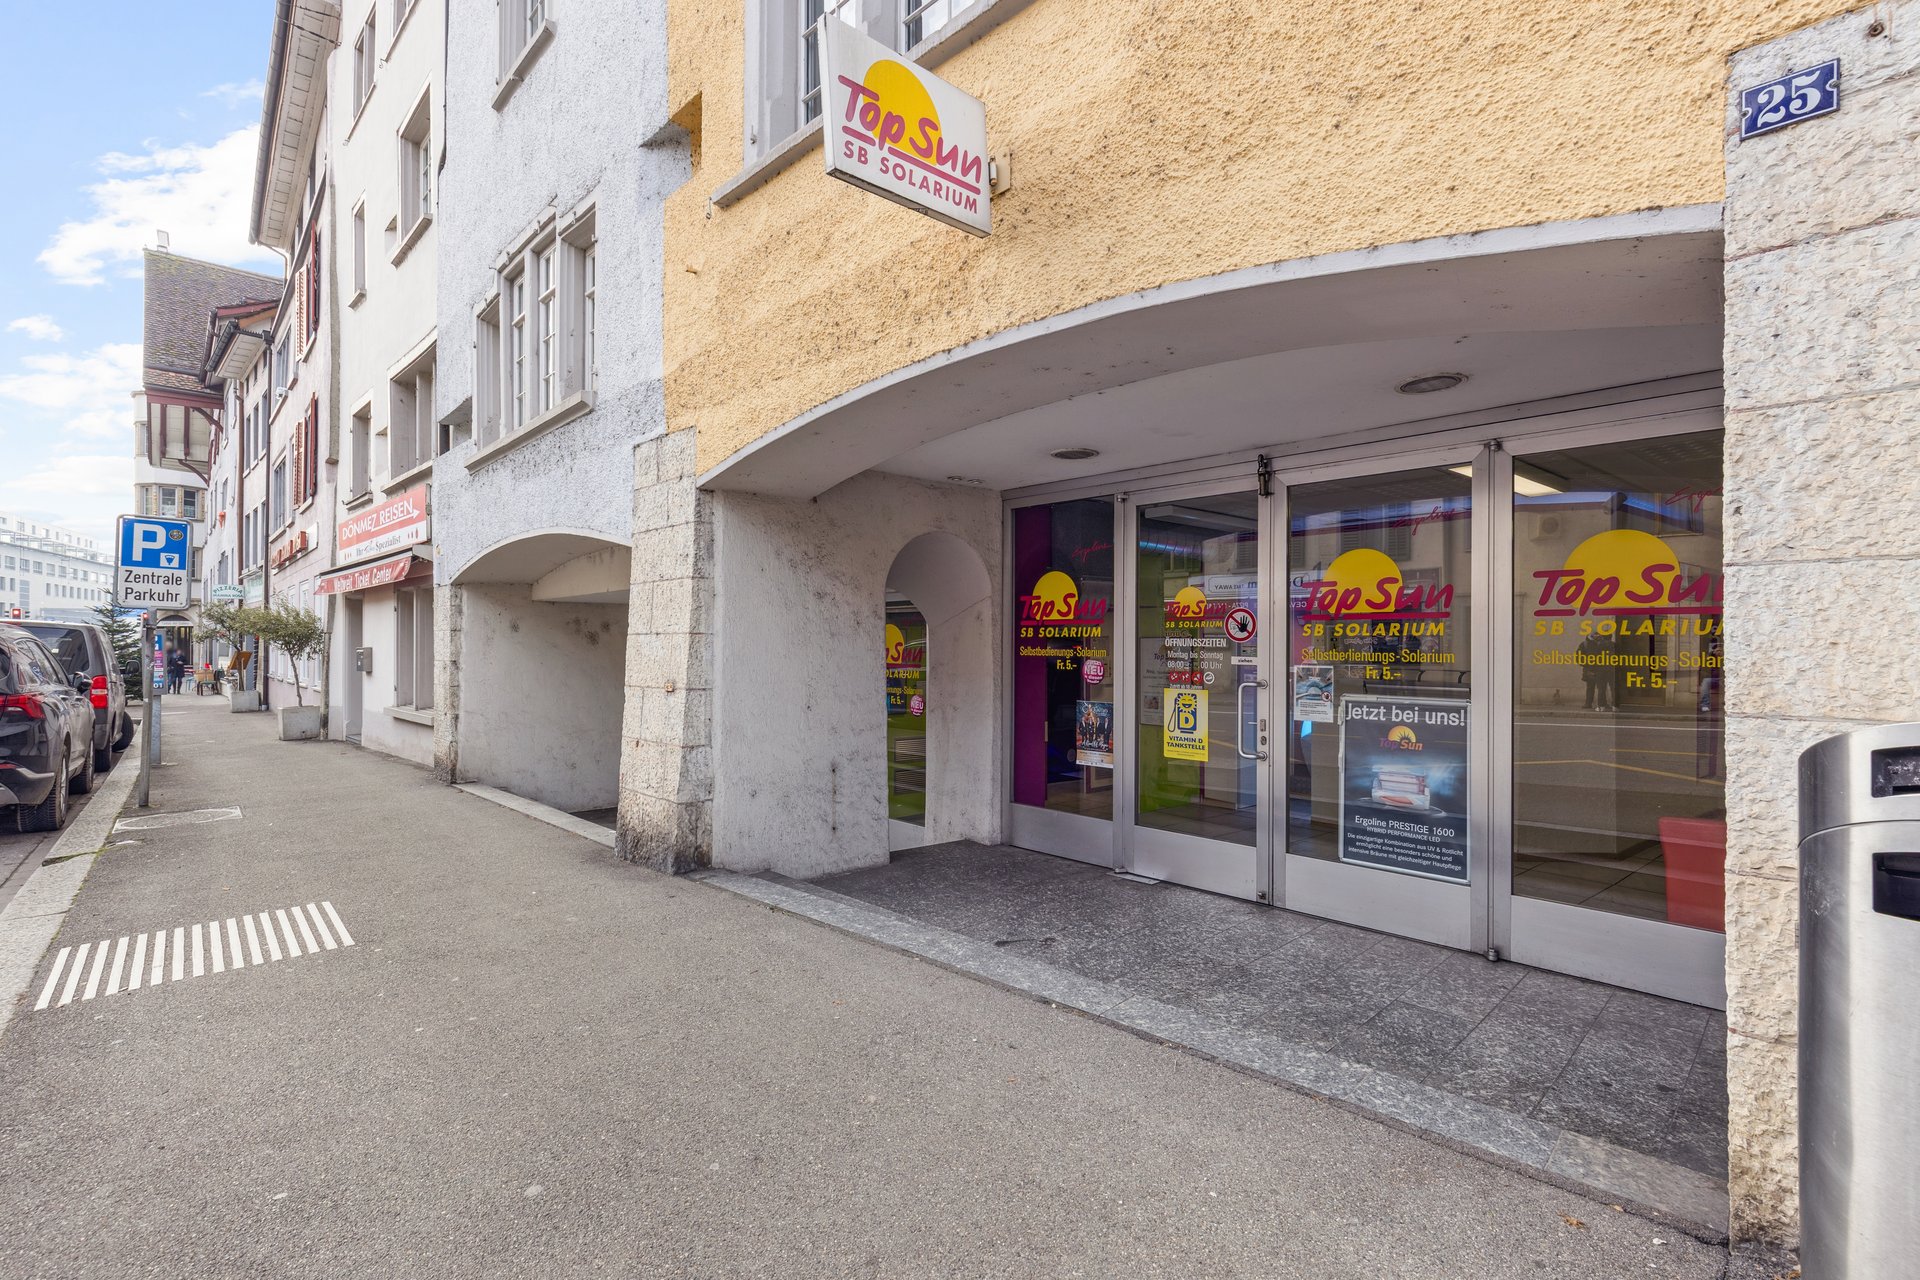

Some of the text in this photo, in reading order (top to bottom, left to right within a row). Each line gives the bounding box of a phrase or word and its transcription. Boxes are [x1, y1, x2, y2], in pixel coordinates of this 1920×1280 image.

[1757, 71, 1821, 128] 25
[838, 75, 982, 184] Top Sun
[843, 140, 978, 214] SB SOLARIUM
[342, 498, 413, 540] DÖNMEZ REISEN
[132, 522, 166, 561] P
[124, 570, 182, 586] Zentrale
[124, 587, 180, 603] Parkuhr
[212, 585, 243, 594] PIZZERIA
[1532, 569, 1620, 617] Top
[1301, 576, 1454, 620] Top Sun
[1020, 592, 1107, 626] Top Sun
[1166, 601, 1191, 618] Top
[1191, 600, 1227, 616] Sun
[1178, 620, 1223, 628] SOLARIUM
[1302, 622, 1446, 637] SB SOLARIUM
[1533, 620, 1565, 636] SB
[1020, 626, 1101, 638] SB SOLARIUM
[1164, 637, 1227, 647] ÖFFNUNGSZEITEN
[1167, 650, 1224, 660] Montag bis Sonntag
[1533, 651, 1724, 669] Selbstbedienungs-Solar
[1056, 659, 1065, 670] Fr.
[1084, 664, 1104, 675] NEU
[1210, 661, 1223, 669] Uhr
[1365, 666, 1380, 679] Fr.
[1626, 672, 1646, 688] Fr.
[1346, 703, 1386, 721] Jetzt
[1391, 705, 1418, 723] bei
[1425, 709, 1465, 727] uns!
[1166, 741, 1206, 751] TANKSTELLE
[1168, 735, 1197, 744] VITAMIN
[1379, 737, 1423, 751] Top Sun
[1355, 815, 1455, 837] Ergoline PRESTIGE 1600
[1366, 826, 1387, 834] HYBRID
[1388, 830, 1428, 841] PERFORMANCE
[1384, 838, 1416, 848] Kombination
[1394, 847, 1420, 856] besonders
